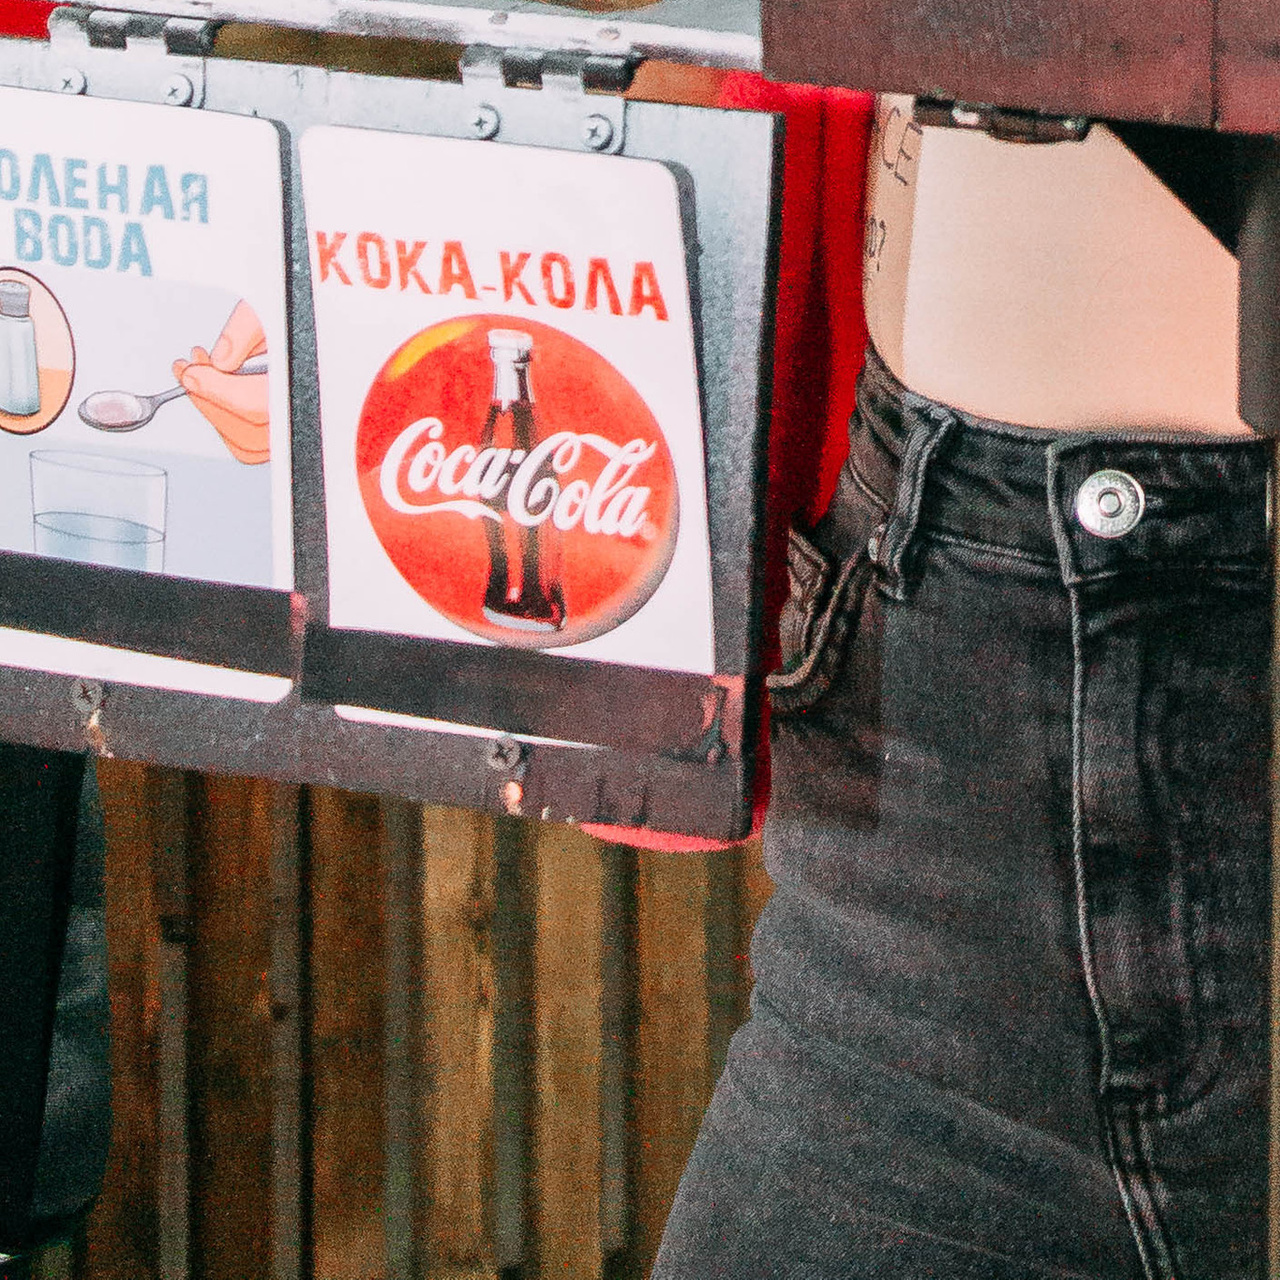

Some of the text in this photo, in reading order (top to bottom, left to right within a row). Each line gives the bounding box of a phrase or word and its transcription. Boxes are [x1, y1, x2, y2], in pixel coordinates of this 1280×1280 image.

[14, 208, 152, 277] ВОДА
[316, 231, 670, 322] КОКА-КОЛА
[379, 416, 658, 538] Coca-Cola
